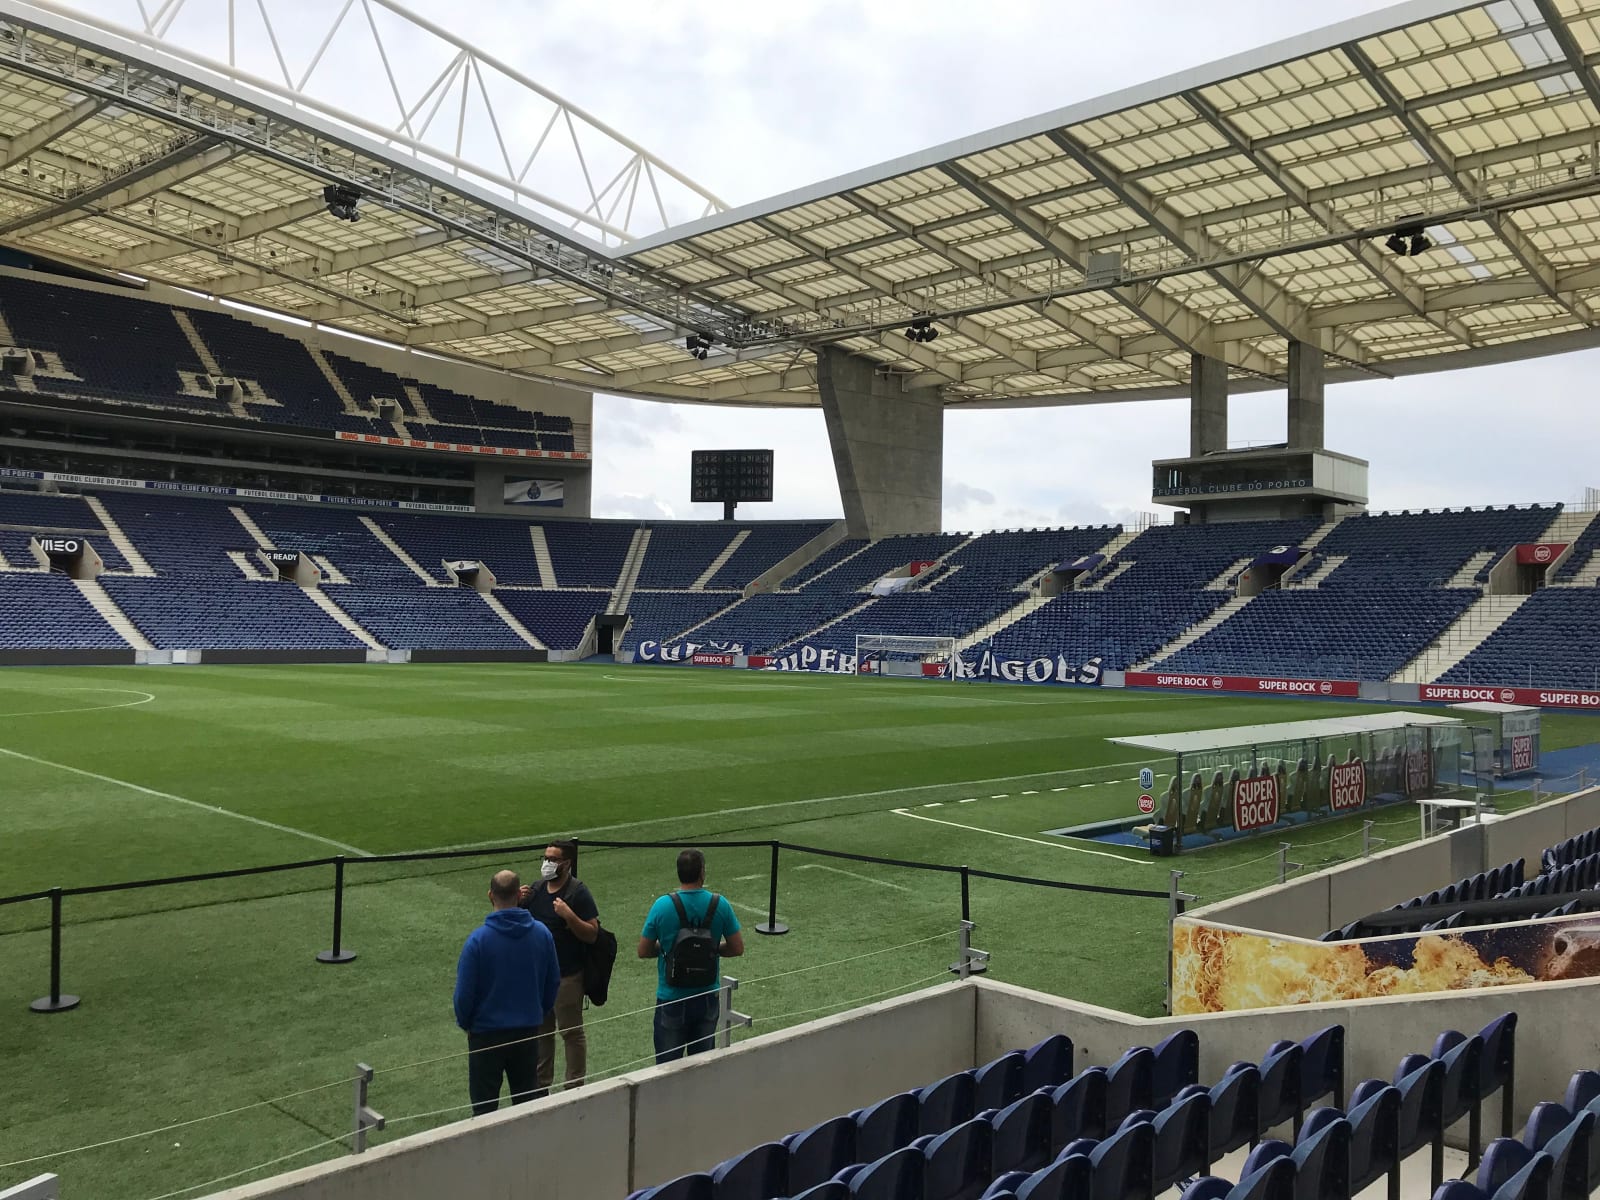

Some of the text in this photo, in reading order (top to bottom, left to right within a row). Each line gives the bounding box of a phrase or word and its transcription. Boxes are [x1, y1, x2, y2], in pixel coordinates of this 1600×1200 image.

[1158, 479, 1306, 496] FUTEBOL CLUBE DO PORTO
[273, 553, 297, 561] READY
[1157, 676, 1183, 686] SUPER
[1184, 677, 1208, 687] BOCK
[1259, 680, 1288, 690] SUPER
[1289, 682, 1316, 692] BOCK
[1426, 688, 1460, 699] SUPER
[1462, 689, 1495, 700] BOCK
[1539, 693, 1579, 704] SUPER
[1515, 738, 1530, 753] SUPER
[1515, 752, 1530, 768] BOCK
[1334, 766, 1361, 788] SUPER
[1239, 780, 1273, 805] SUPER
[1336, 785, 1360, 808] BOCK
[1241, 801, 1272, 827] BOCK
